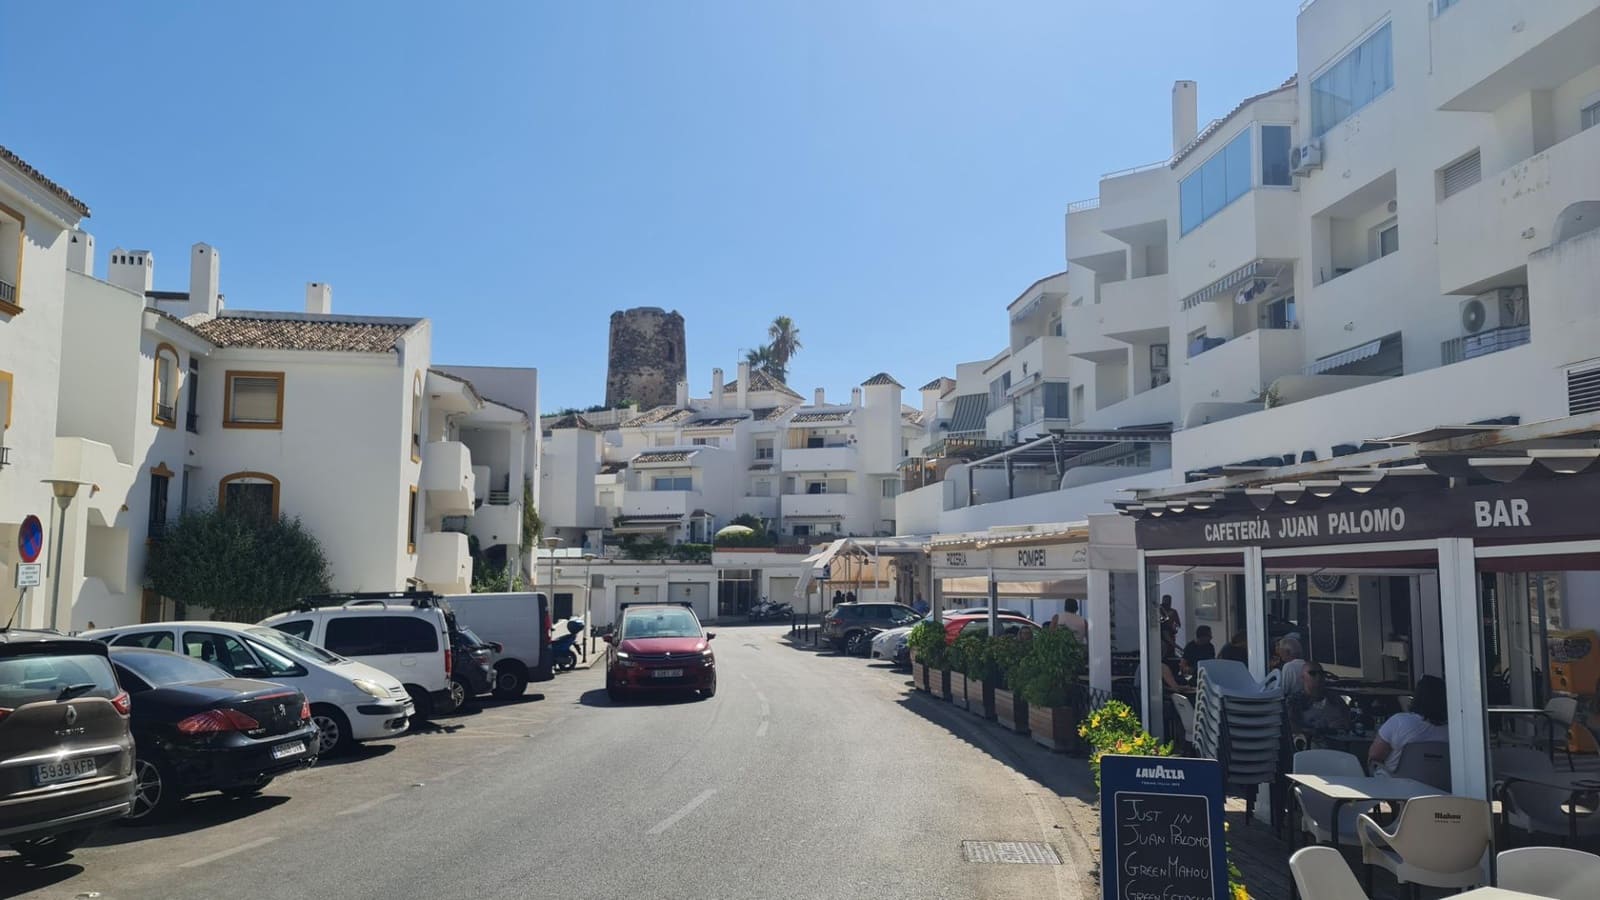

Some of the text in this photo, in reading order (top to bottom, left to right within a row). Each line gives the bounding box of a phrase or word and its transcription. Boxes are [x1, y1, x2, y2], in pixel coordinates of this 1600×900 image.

[1205, 507, 1405, 541] CAFETERÍA JUAN PALOMO
[1474, 498, 1532, 528] BAR
[1018, 549, 1047, 566] POMPEI
[40, 763, 71, 779] 5939
[1136, 765, 1185, 780] LAVAZZA
[1123, 824, 1209, 848] JUAN PALOMO
[1124, 851, 1209, 880] GREEN MAHOU
